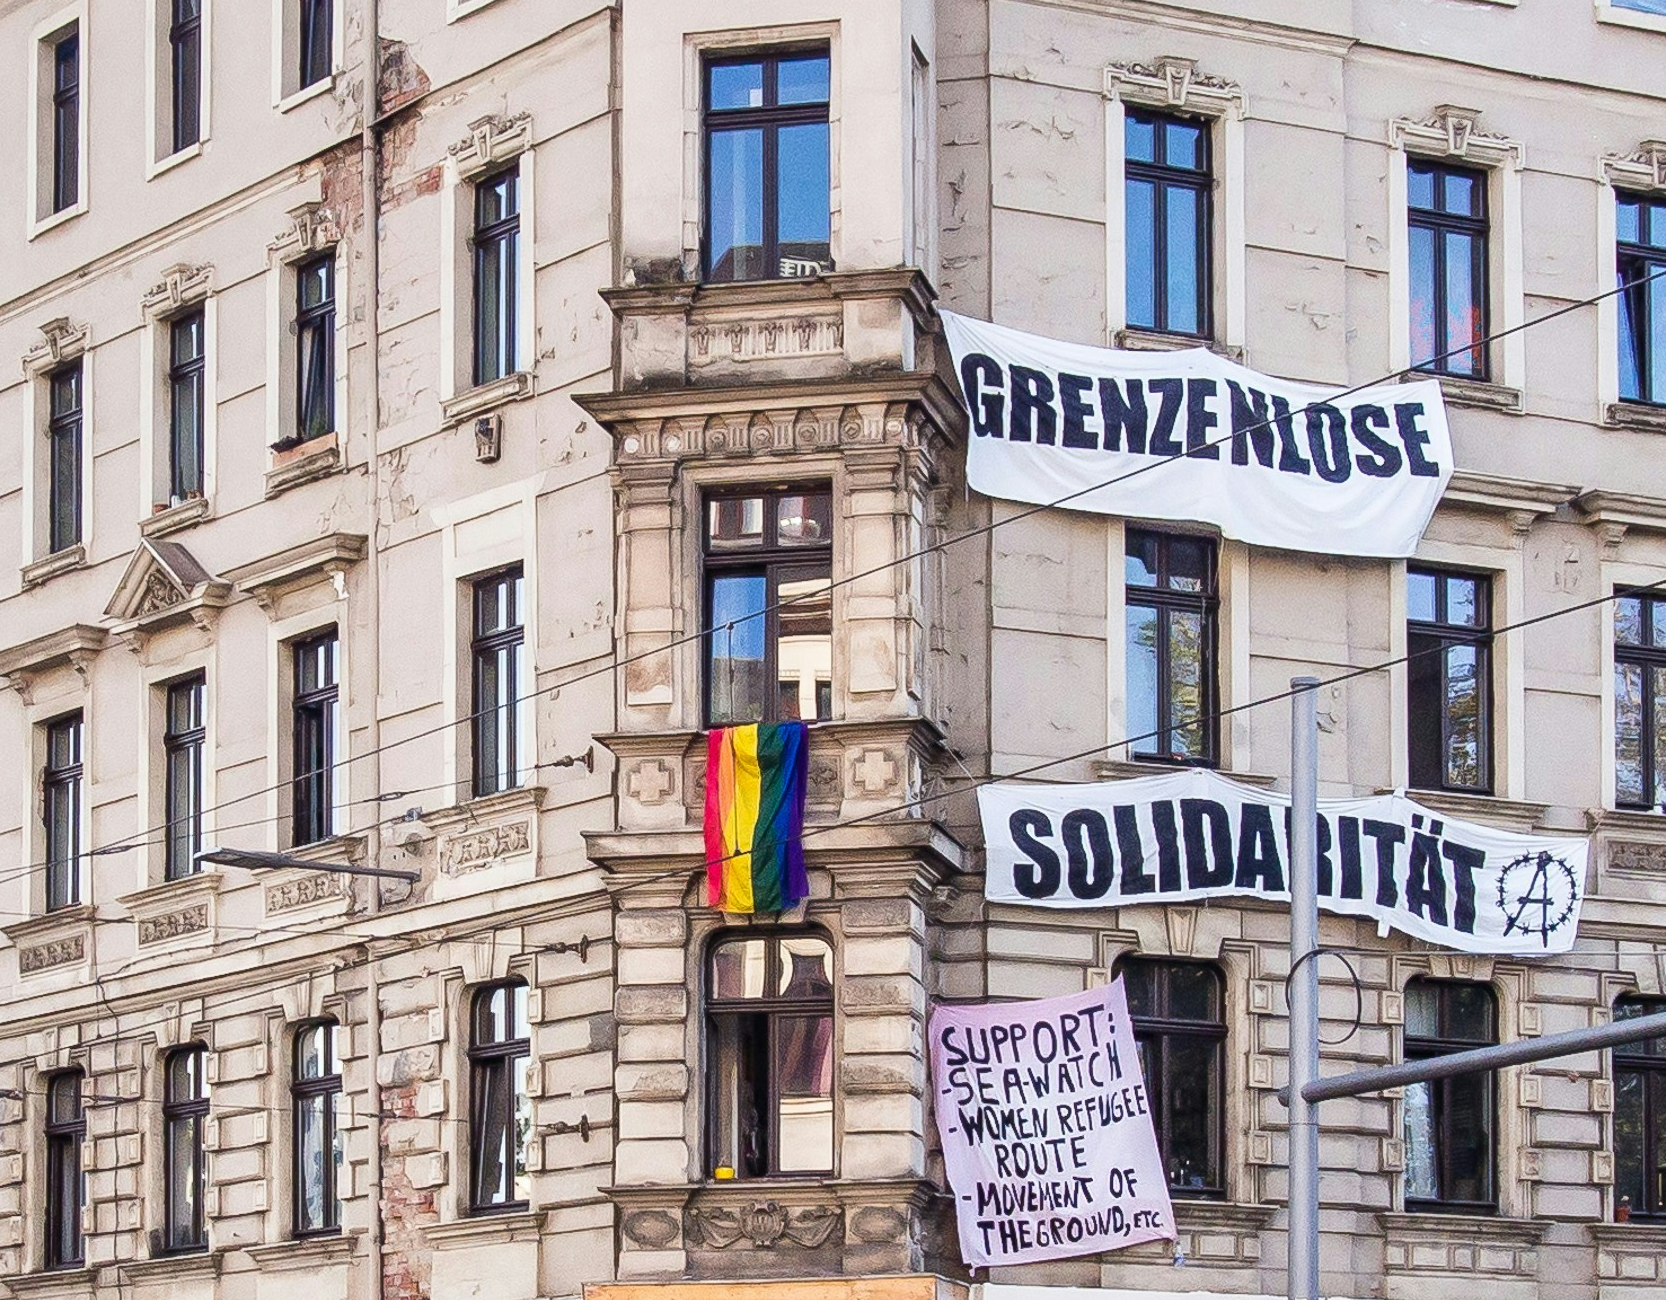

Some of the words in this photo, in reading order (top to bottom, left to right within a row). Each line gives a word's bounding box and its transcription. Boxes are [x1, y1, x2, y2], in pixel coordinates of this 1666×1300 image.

[960, 352, 1440, 484] GRENZENLOSE
[940, 1004, 1116, 1067] SUPPORT:
[1056, 1084, 1148, 1136] REFUGEE
[993, 1135, 1088, 1179] ROUTE
[1109, 1167, 1139, 1199] OF
